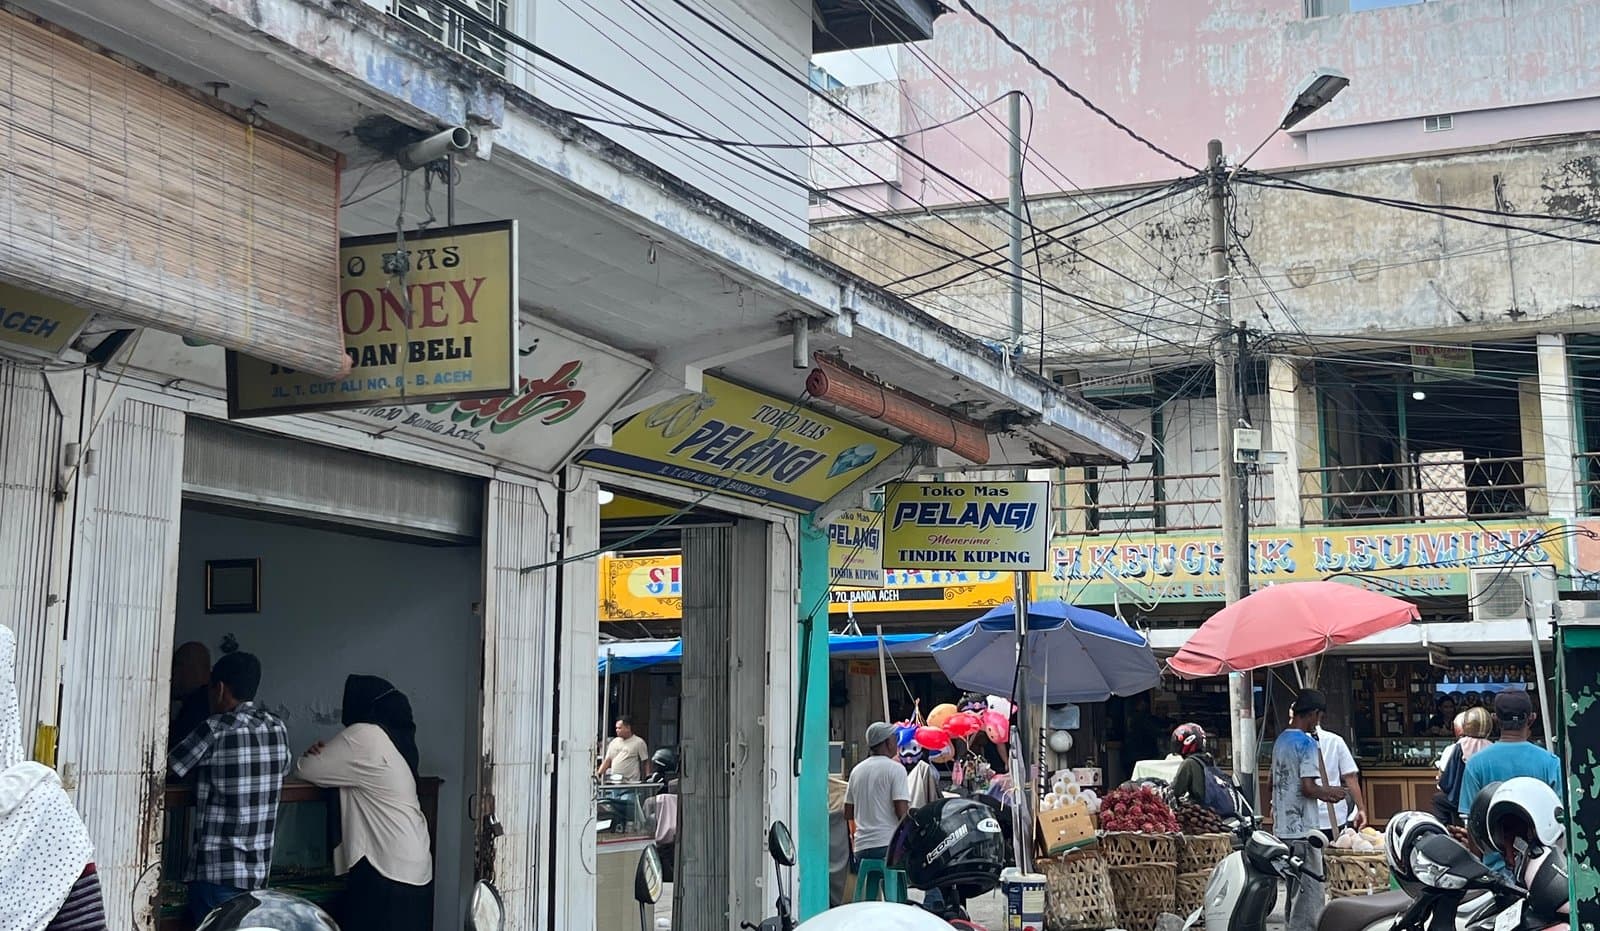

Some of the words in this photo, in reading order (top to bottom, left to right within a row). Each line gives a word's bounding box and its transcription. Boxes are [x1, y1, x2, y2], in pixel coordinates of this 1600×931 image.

[382, 246, 460, 274] AS
[340, 277, 487, 336] ONEY
[408, 336, 473, 363] BELI
[309, 381, 336, 395] CUT
[340, 379, 363, 393] ALI
[368, 377, 390, 391] NO.
[415, 373, 429, 386] B.
[433, 369, 473, 385] ACEH
[401, 412, 445, 433] Banda
[441, 423, 485, 450] Aceh
[752, 405, 797, 429] TOKO
[794, 416, 832, 441] MAS
[666, 419, 827, 484] PELANGI
[920, 486, 965, 497] Toko
[974, 486, 1009, 497] Mas
[891, 501, 1038, 532] PELANGI
[828, 523, 880, 550] PELANGI
[927, 534, 991, 546] Menerima
[898, 550, 957, 564] TINDIK
[964, 550, 1030, 564] KUPING
[1312, 528, 1552, 573] LEUMIEK
[855, 569, 879, 580] KUPING
[850, 590, 876, 603] BANDA
[879, 589, 899, 602] ACEH
